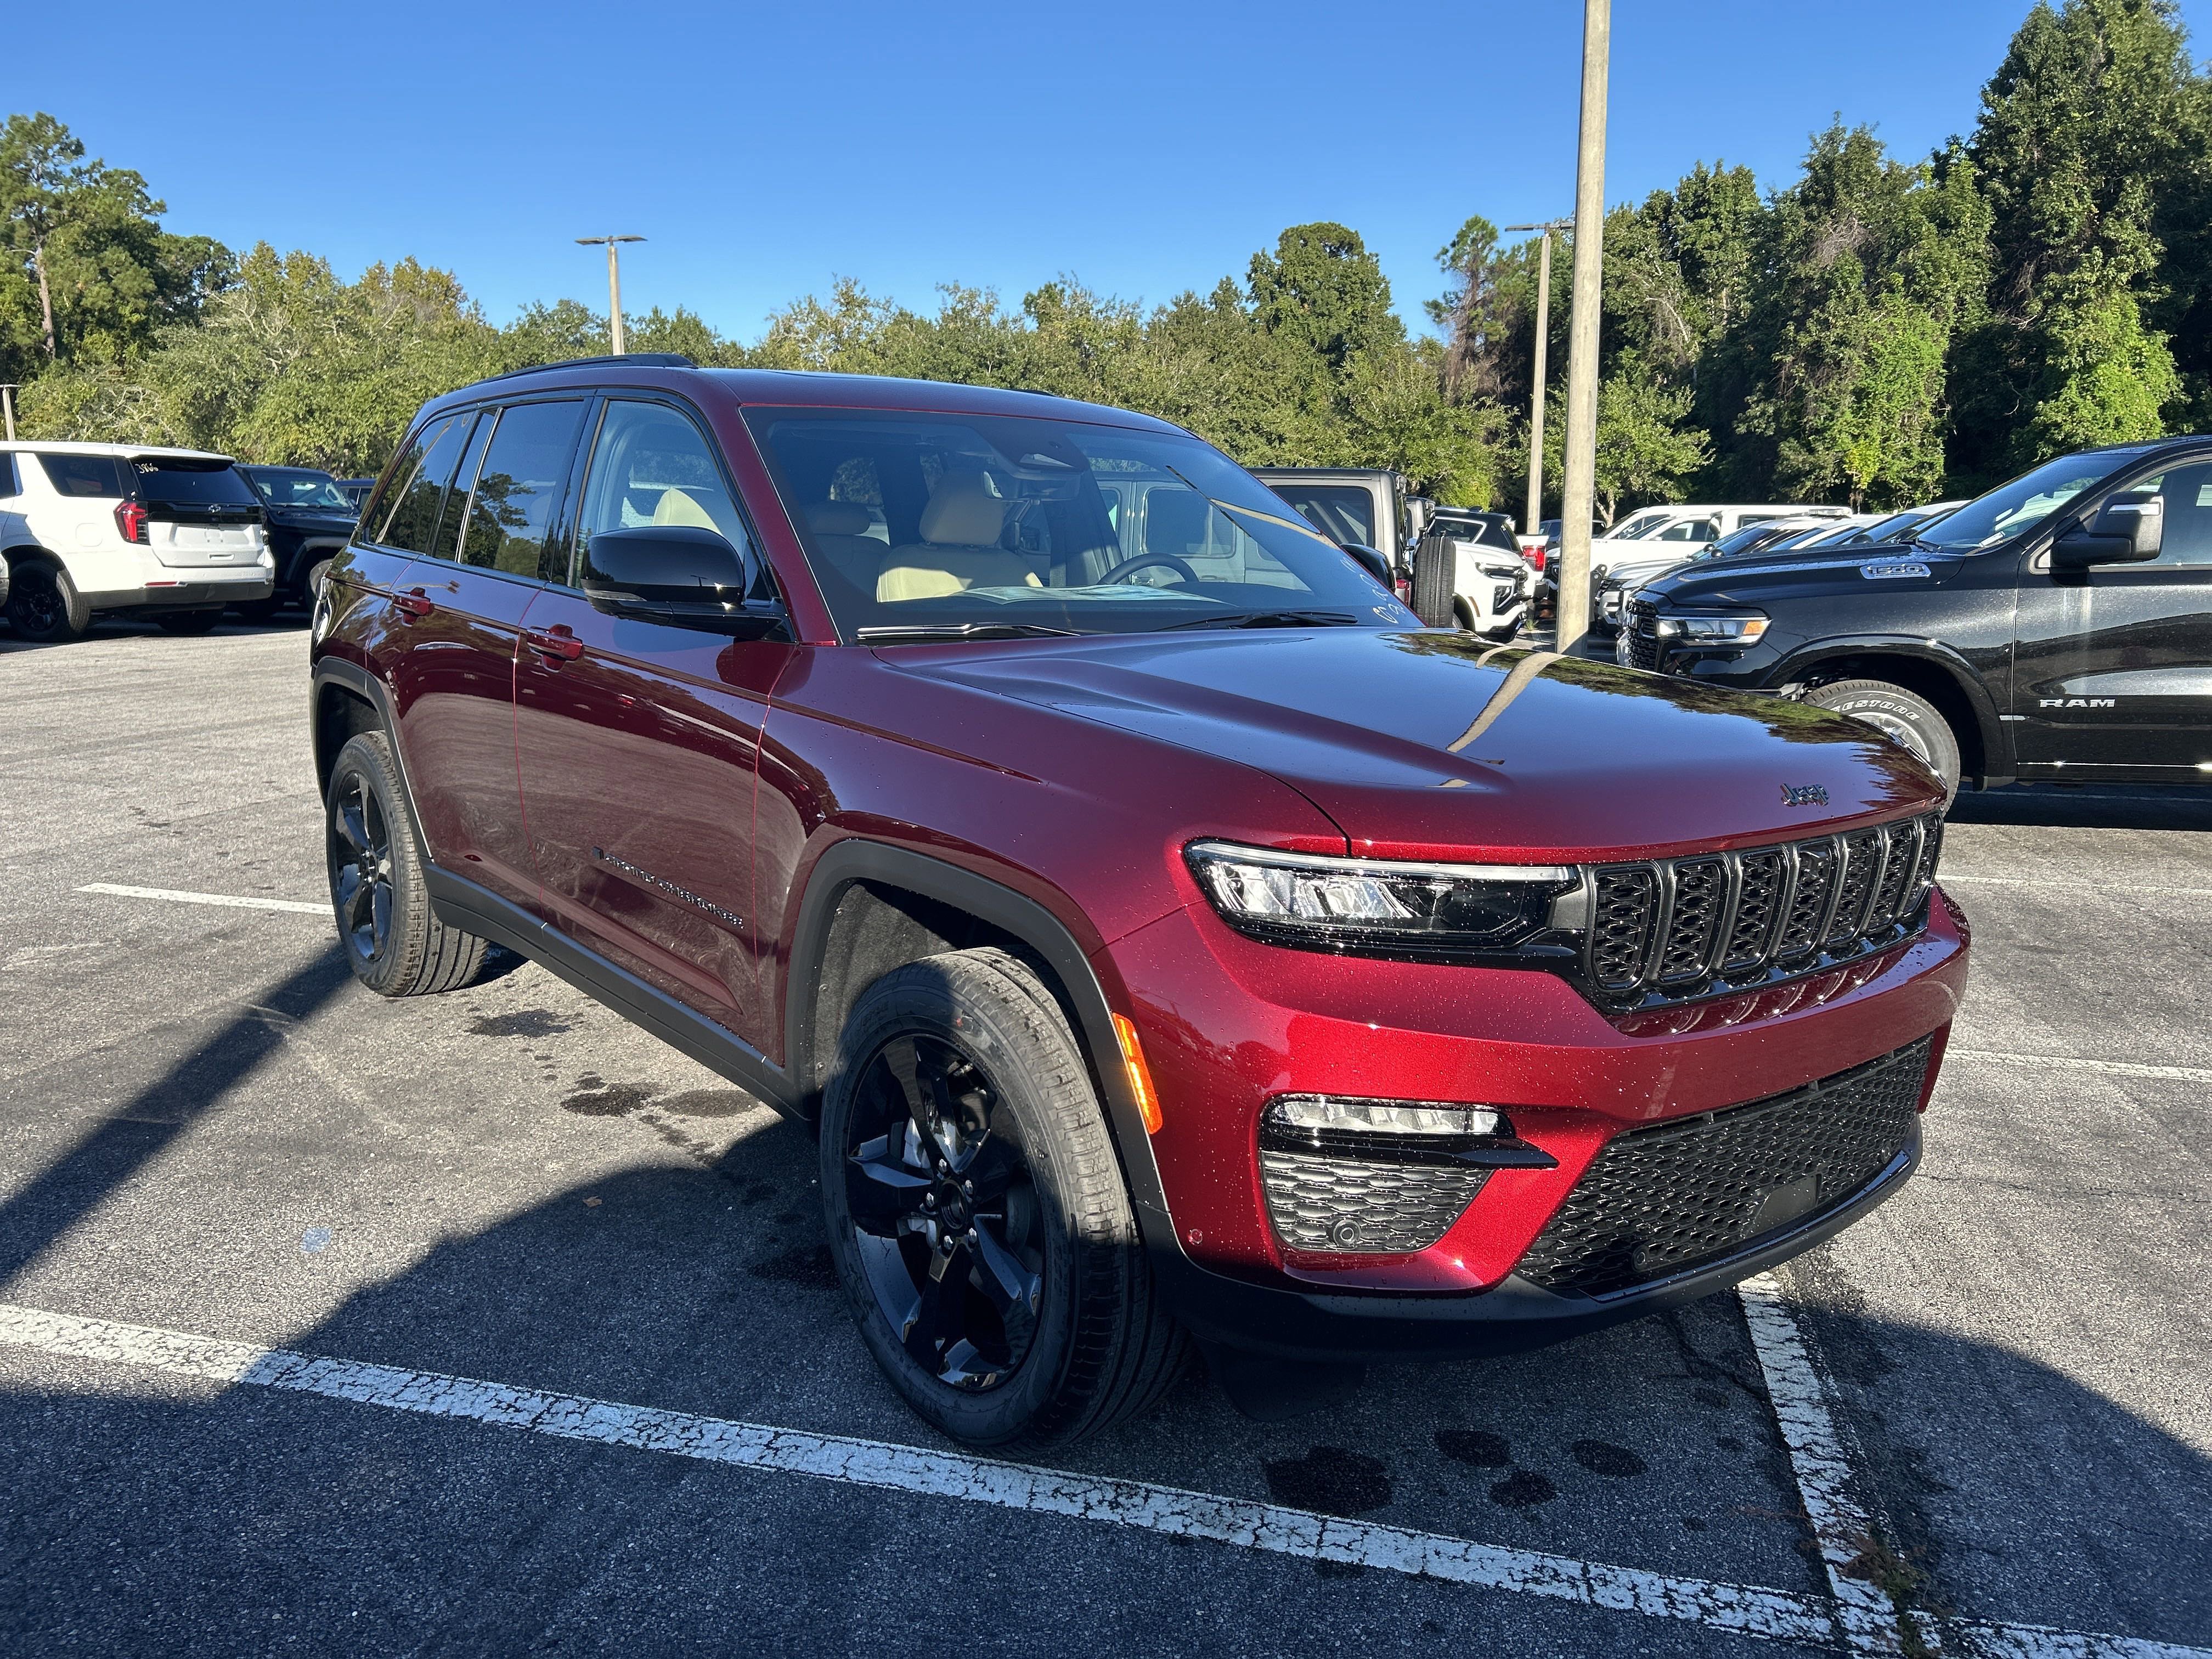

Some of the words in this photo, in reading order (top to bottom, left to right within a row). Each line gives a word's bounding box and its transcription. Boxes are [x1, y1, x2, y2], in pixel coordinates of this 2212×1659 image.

[1867, 565, 1925, 574] 1500
[2039, 699, 2115, 708] RAM
[1780, 783, 1830, 806] Jeep
